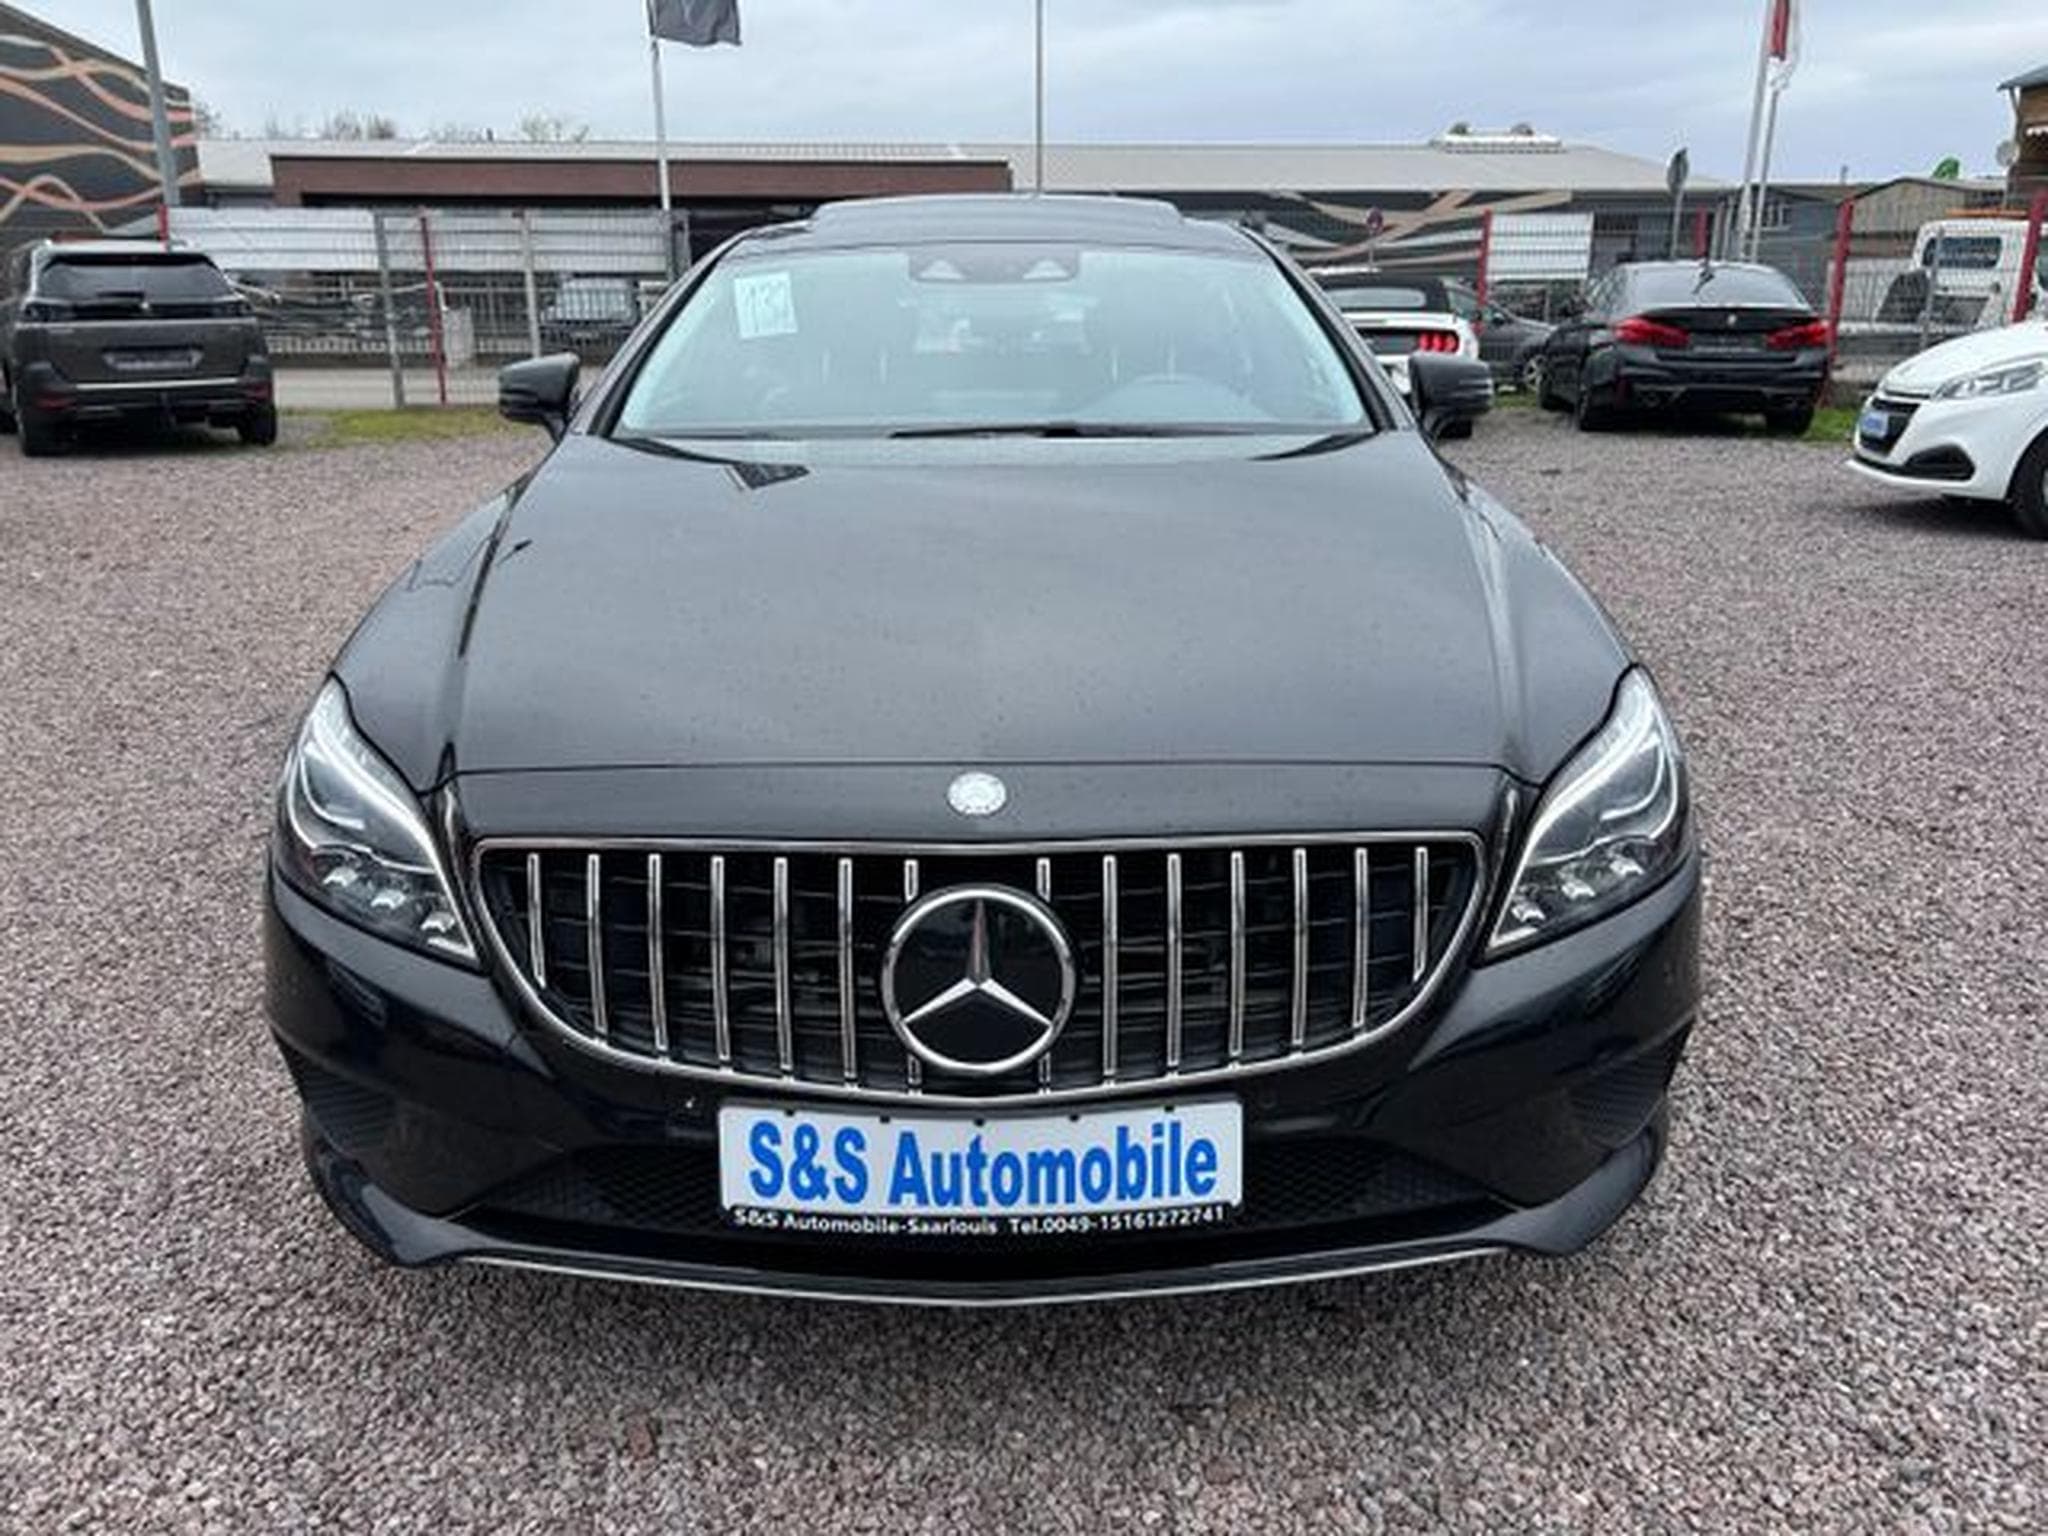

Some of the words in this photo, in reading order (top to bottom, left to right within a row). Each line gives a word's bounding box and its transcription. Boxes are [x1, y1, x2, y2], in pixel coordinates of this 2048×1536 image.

[748, 1120, 868, 1204] S&S
[888, 1120, 1218, 1207] Automobile
[734, 1208, 778, 1227] S&S
[783, 1214, 998, 1235] Automobile-Saarlouis
